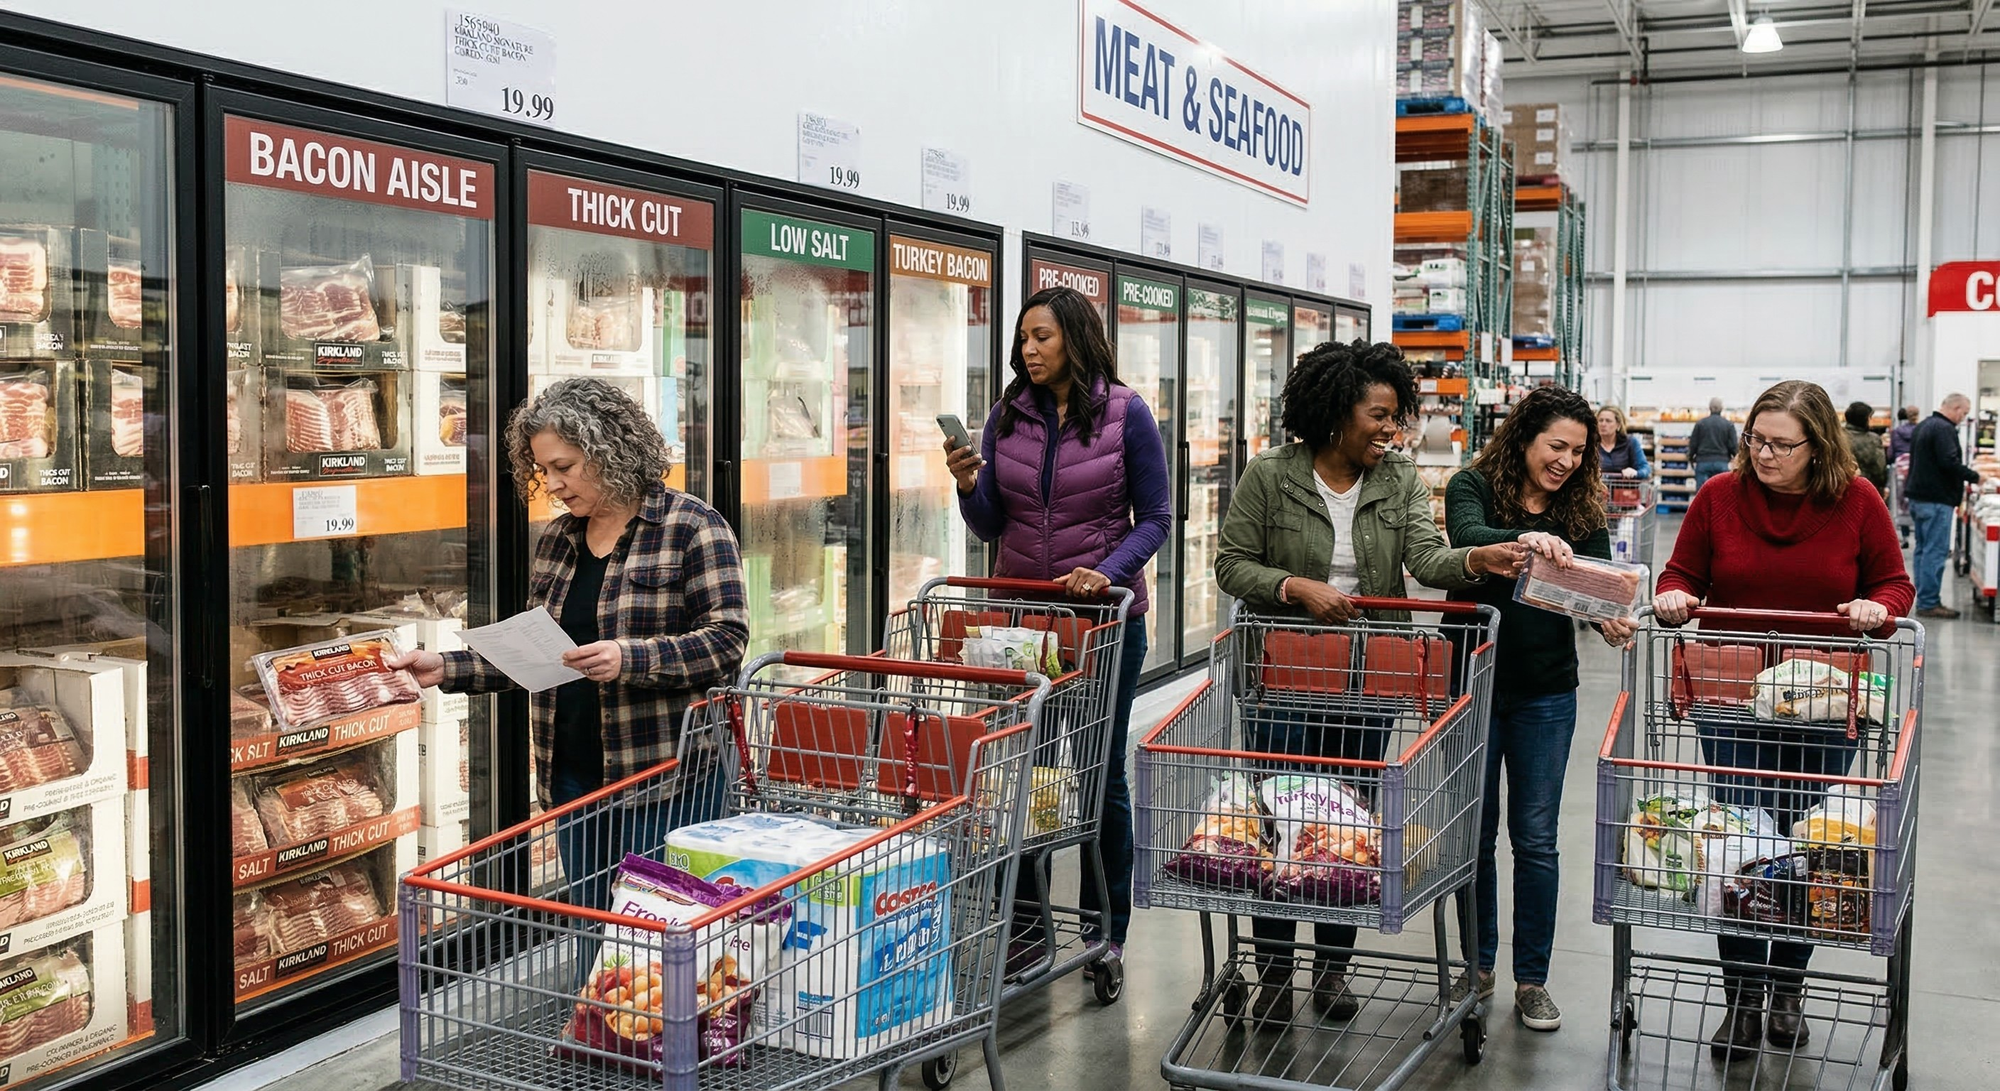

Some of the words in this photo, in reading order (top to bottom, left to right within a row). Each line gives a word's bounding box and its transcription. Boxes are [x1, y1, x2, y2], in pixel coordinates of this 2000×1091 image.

[502, 87, 554, 121] 19.99
[1095, 15, 1175, 121] MEAT
[1183, 64, 1201, 135] &
[1208, 77, 1304, 177] SEAFOOD
[250, 131, 376, 193] BACON
[387, 157, 477, 209] AISLE
[830, 166, 860, 189] 19.99
[567, 187, 636, 231] THICK
[641, 200, 682, 237] CUT
[946, 193, 970, 212] 19.99
[771, 222, 808, 255] LOW
[811, 229, 849, 261] SALT
[892, 243, 944, 276] TURKEY
[947, 253, 988, 282] BACON
[1038, 267, 1100, 297] PRE-COOKED
[1123, 281, 1174, 308] PRE-COOKED
[1966, 271, 2000, 310] C
[318, 346, 362, 358] KIRKLAND
[322, 456, 365, 468] KIRKLAND
[41, 476, 69, 485] BACON
[325, 518, 354, 532] 19.99
[328, 664, 345, 676] CUT
[279, 727, 329, 748] KIRKLAND
[334, 720, 366, 741] THICK
[368, 714, 390, 733] CUT
[6, 840, 48, 860] KIRKLAND
[238, 857, 271, 880] SALT
[278, 839, 328, 863] KIRKLAND
[332, 830, 365, 852] THICK
[367, 821, 391, 841] CUT
[239, 966, 271, 989] SALT
[278, 945, 327, 970] KIRKLAND
[332, 934, 365, 956] THICK
[367, 924, 389, 945] CUT
